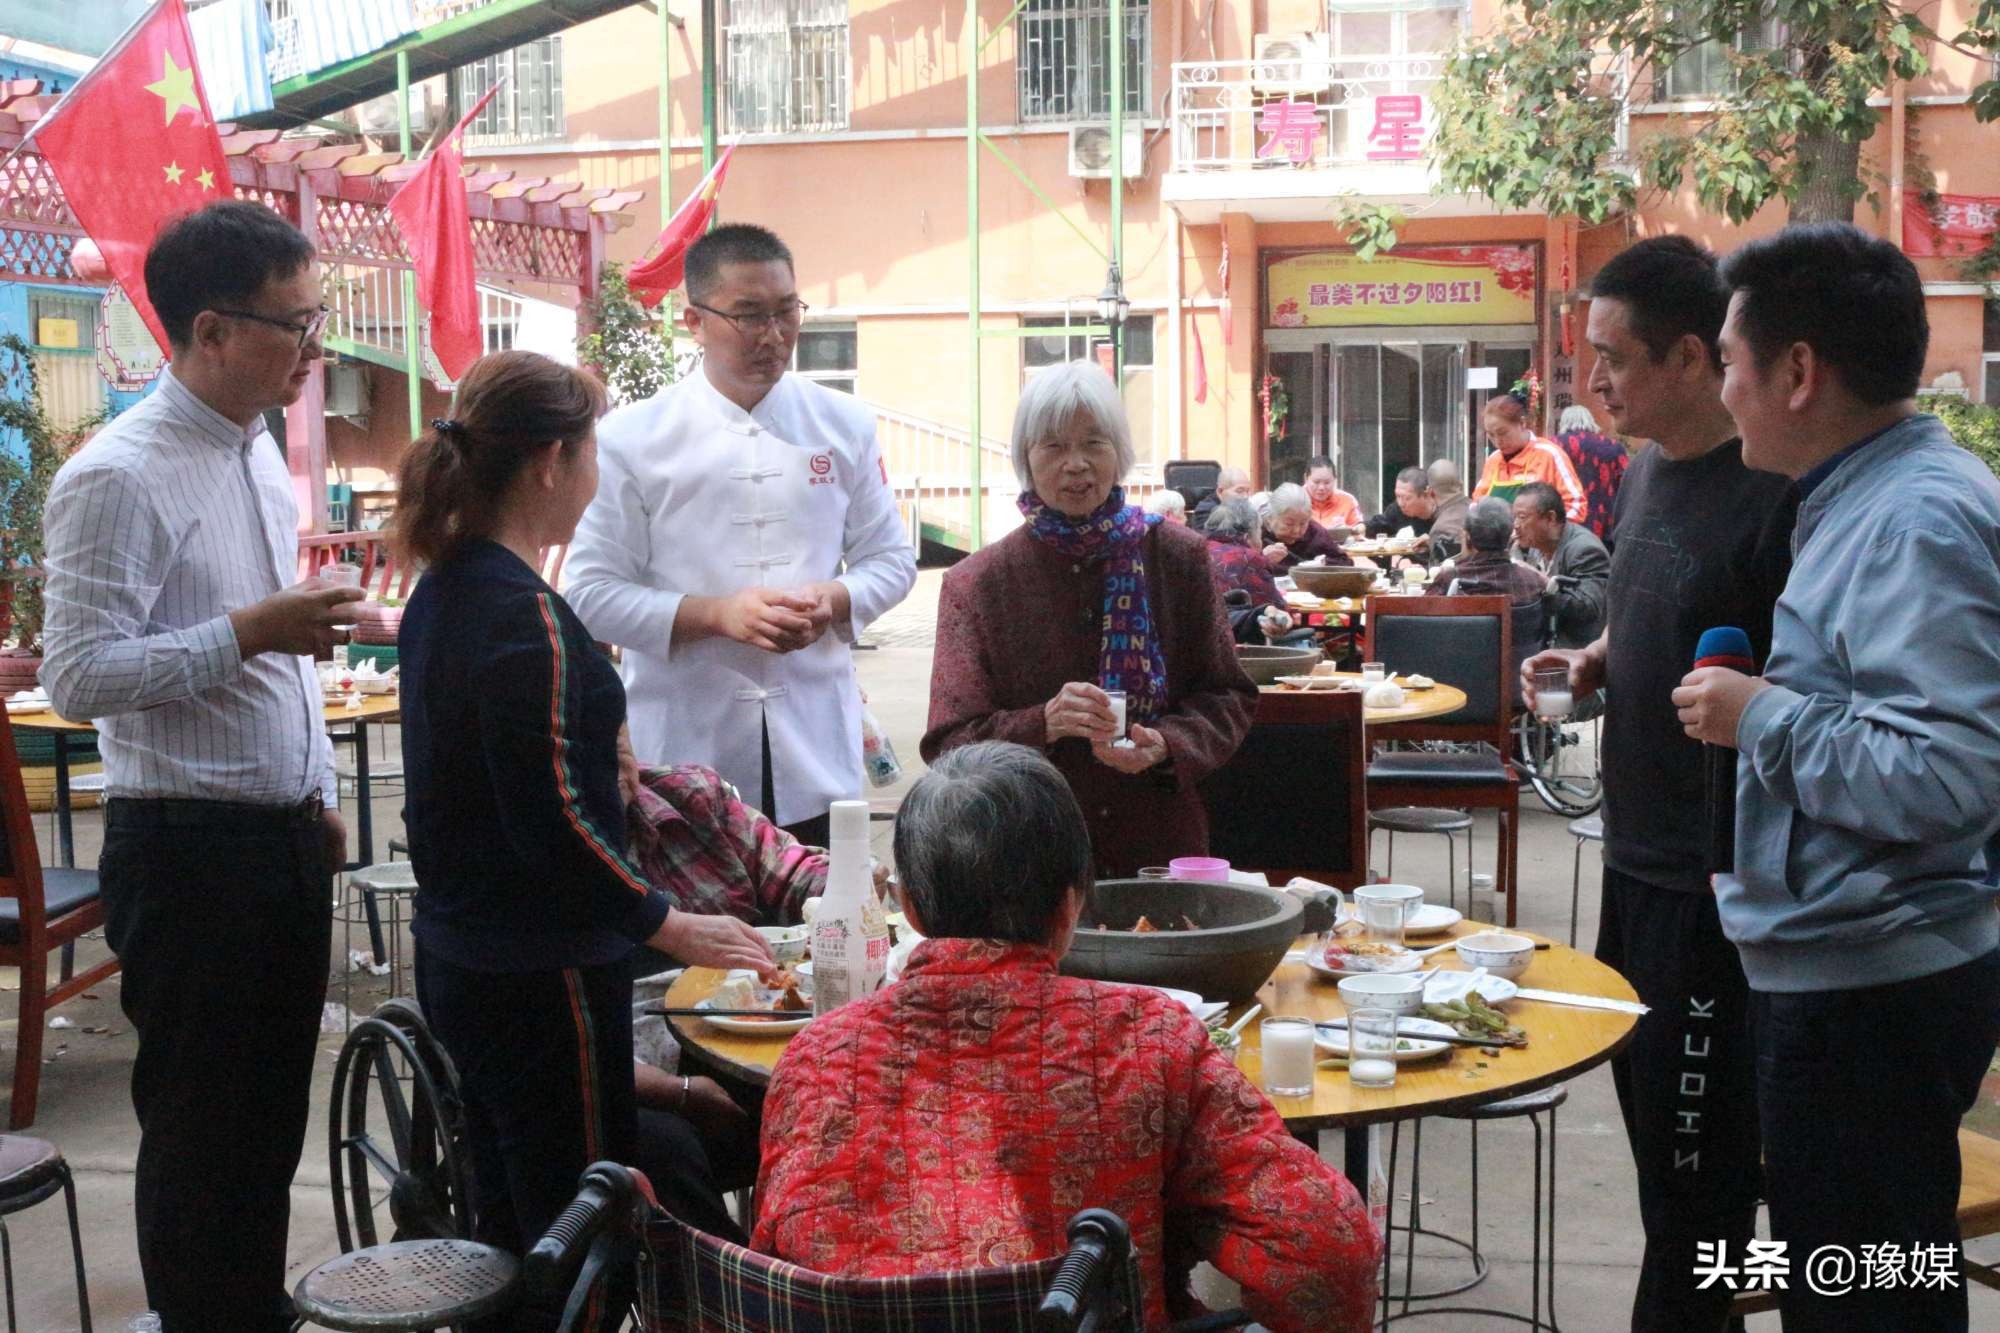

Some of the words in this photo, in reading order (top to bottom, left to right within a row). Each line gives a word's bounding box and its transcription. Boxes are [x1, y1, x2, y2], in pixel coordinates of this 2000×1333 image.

[1308, 281, 1483, 306] 最美不过夕阳红!
[1674, 996, 1715, 1172] SHOCK
